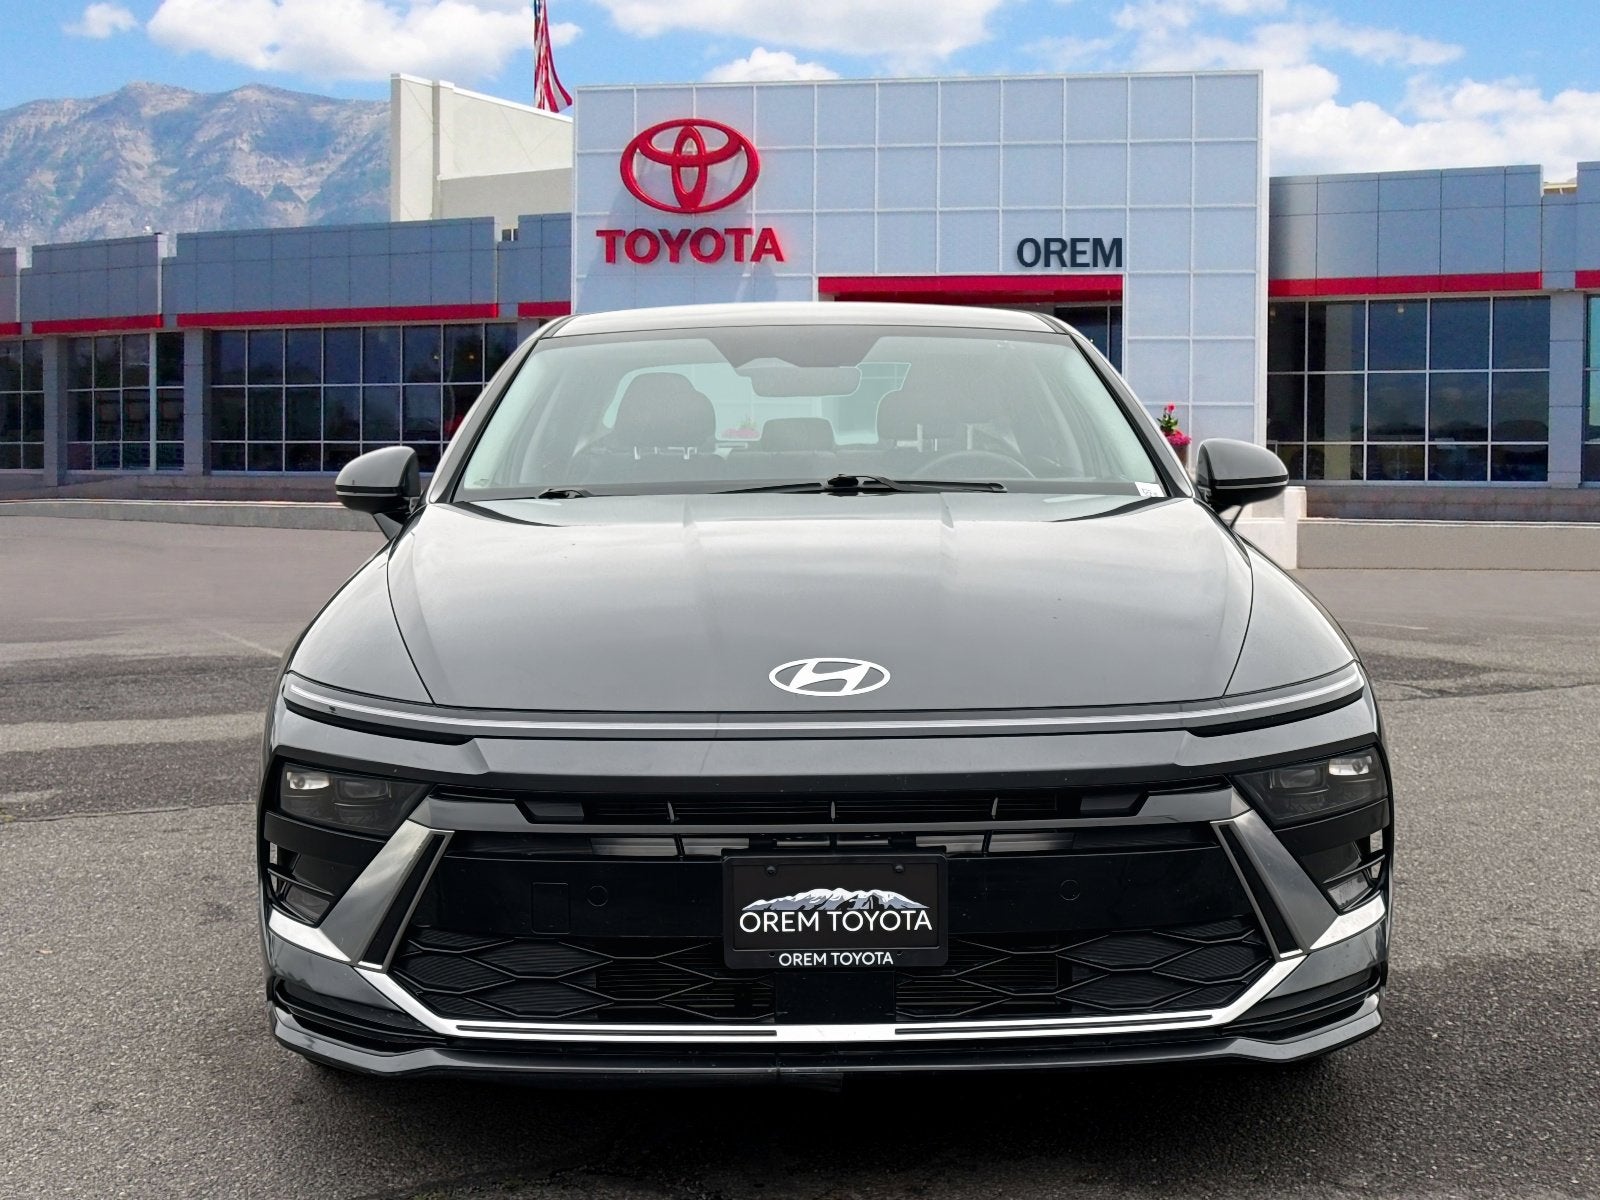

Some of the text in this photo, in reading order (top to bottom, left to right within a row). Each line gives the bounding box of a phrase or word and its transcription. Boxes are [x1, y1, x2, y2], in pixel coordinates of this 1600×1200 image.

[596, 227, 785, 264] TOYOTA
[1016, 237, 1124, 269] OREM
[739, 910, 933, 933] OREM TOYOTA
[778, 951, 894, 967] OREM TOYOTA
